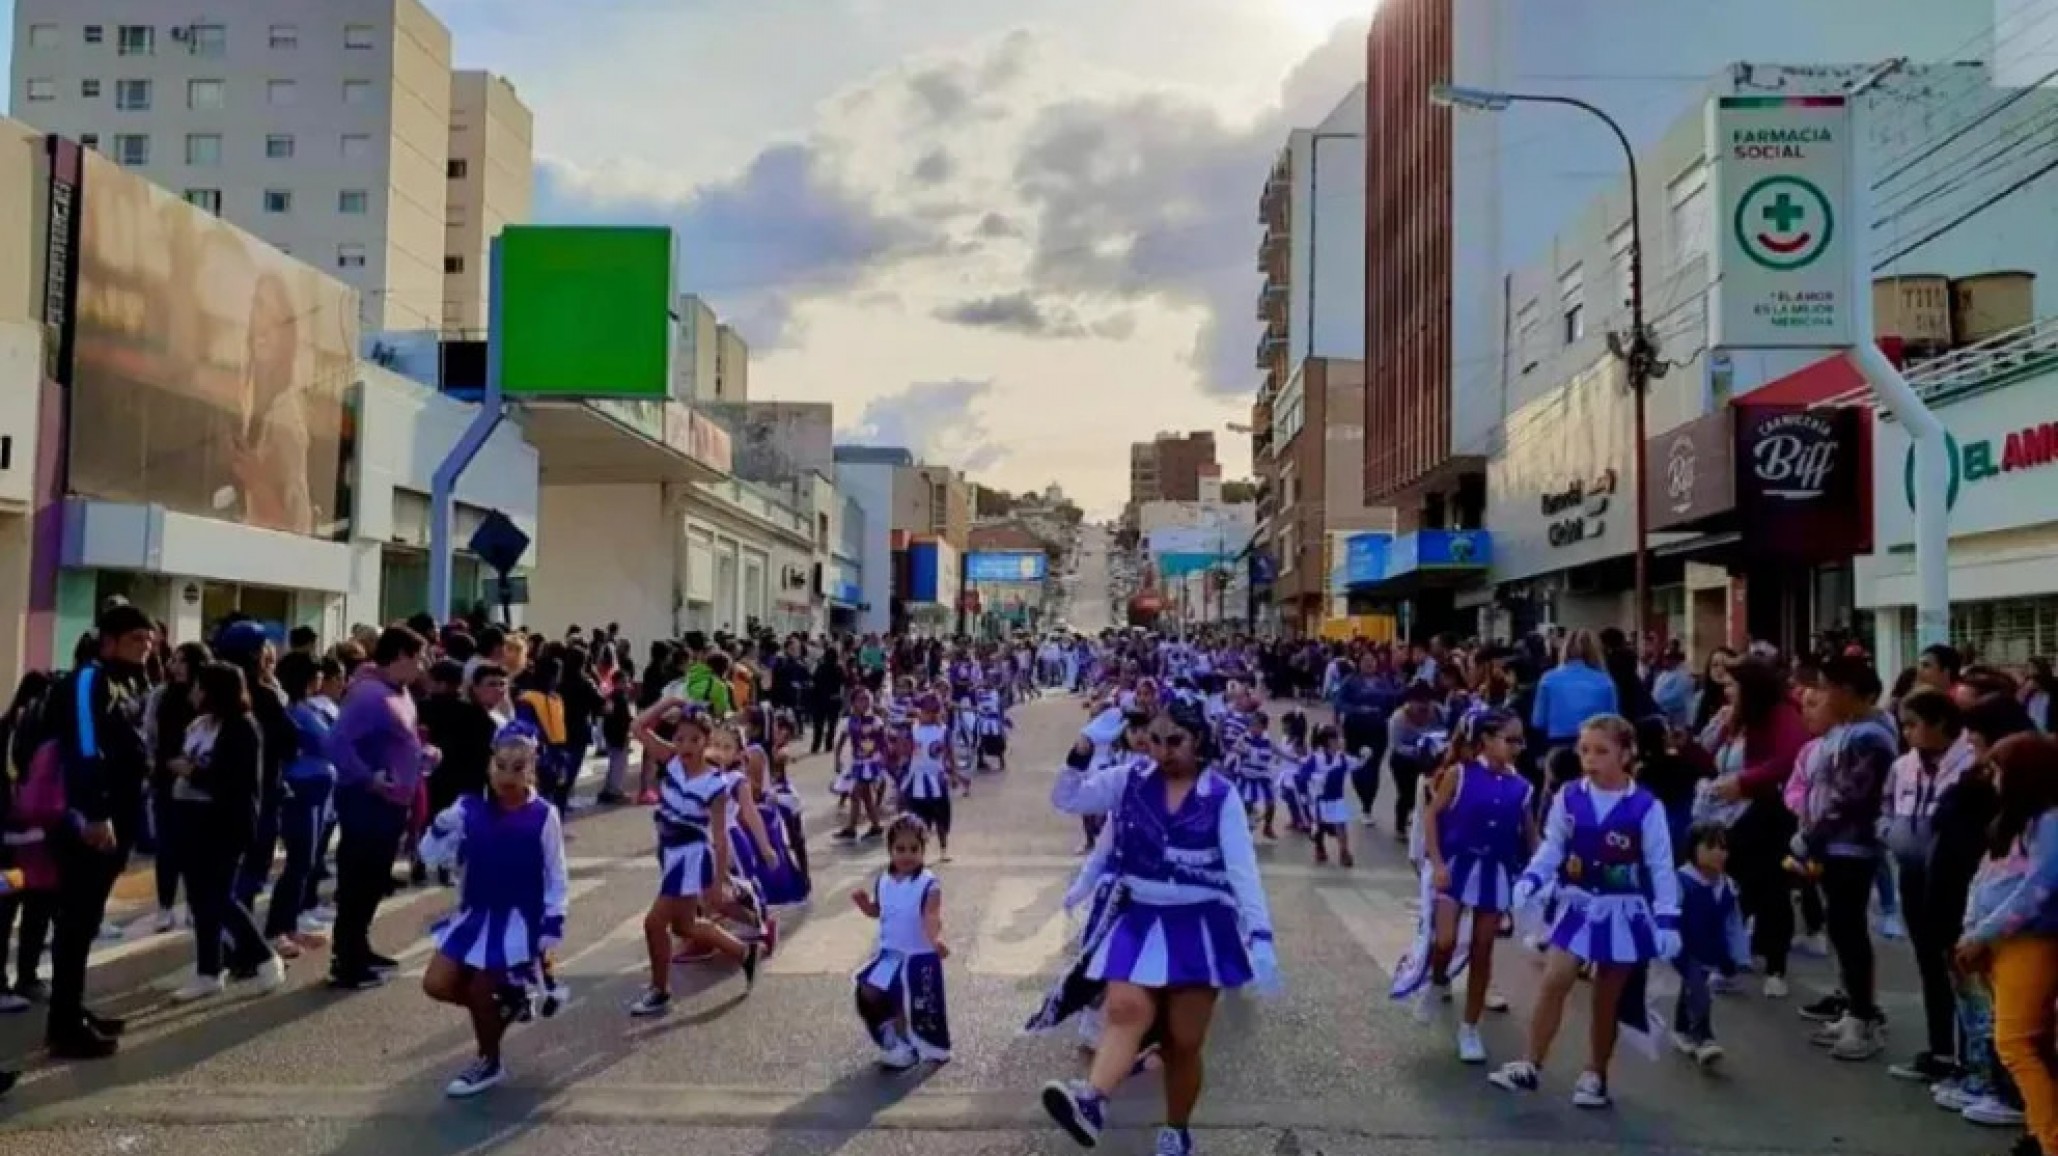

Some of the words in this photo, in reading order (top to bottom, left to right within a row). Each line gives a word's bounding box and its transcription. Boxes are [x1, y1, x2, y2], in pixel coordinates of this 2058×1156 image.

[1733, 127, 1832, 142] FARMACIA
[1734, 144, 1805, 159] SOCIAL
[1796, 291, 1834, 302] AMOR
[1790, 304, 1834, 314] MEJOR
[1753, 435, 1839, 489] Biff
[1962, 439, 1999, 481] EL
